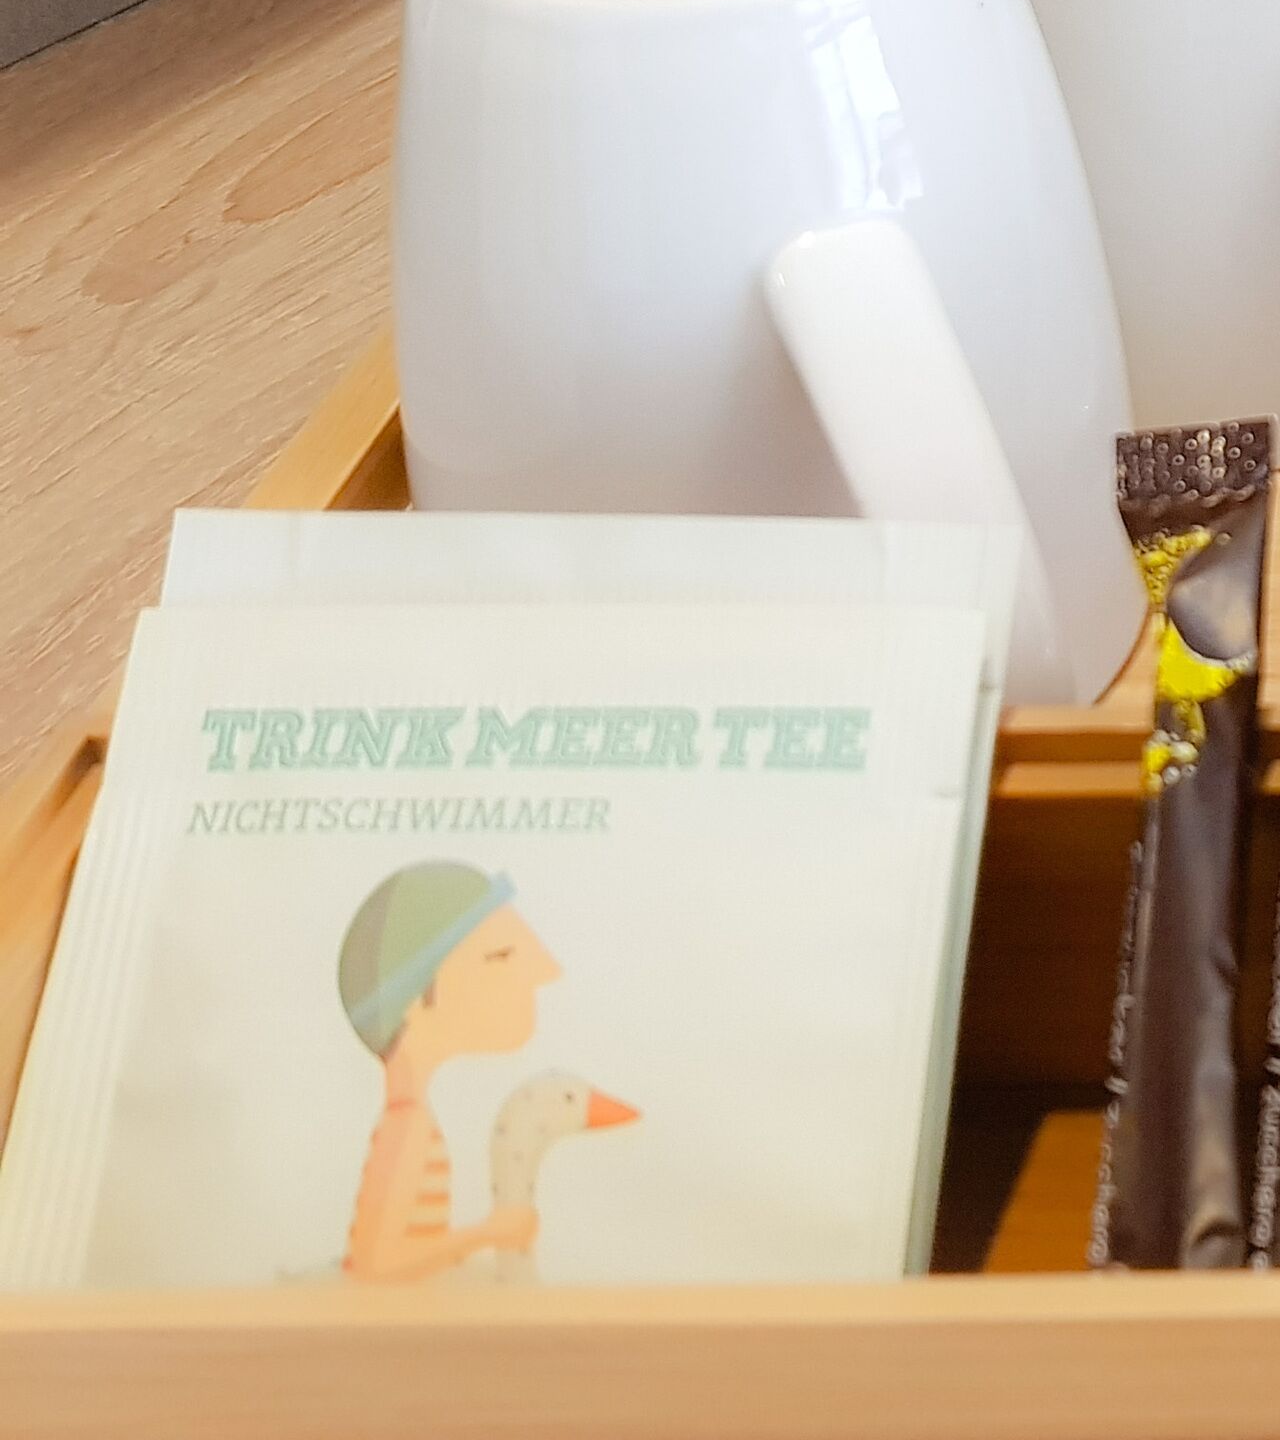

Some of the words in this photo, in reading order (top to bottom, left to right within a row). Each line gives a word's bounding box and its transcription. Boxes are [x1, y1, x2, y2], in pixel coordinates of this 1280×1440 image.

[202, 707, 467, 773] TRINK
[466, 706, 701, 771] MEER
[712, 706, 873, 775] TEE
[186, 796, 612, 836] NICHTSCHWIMMER
